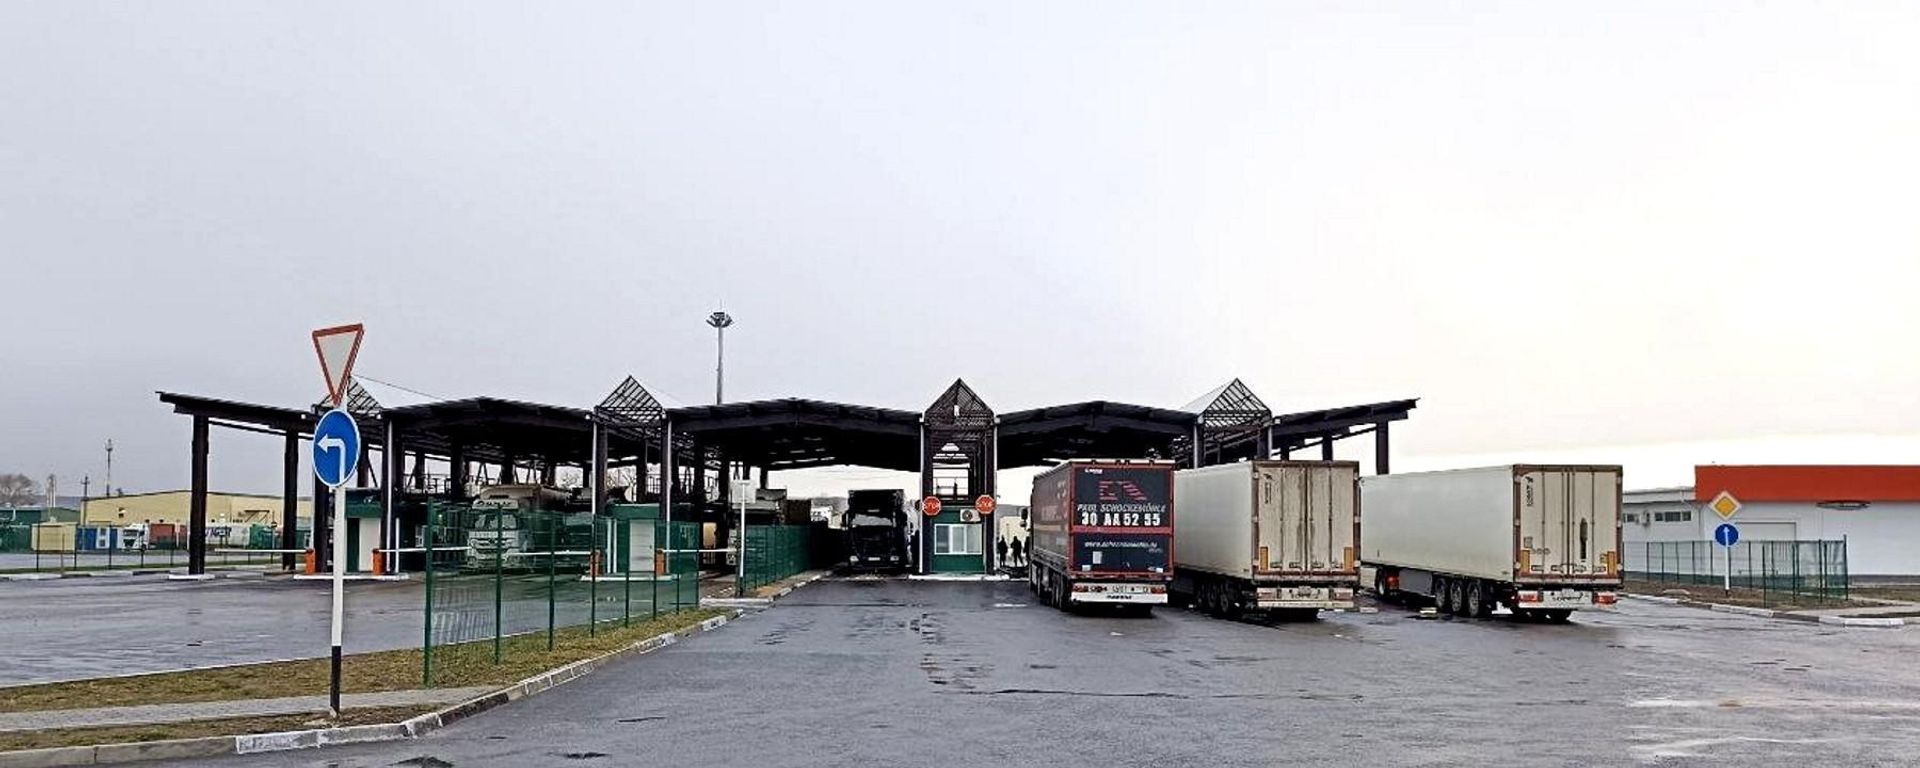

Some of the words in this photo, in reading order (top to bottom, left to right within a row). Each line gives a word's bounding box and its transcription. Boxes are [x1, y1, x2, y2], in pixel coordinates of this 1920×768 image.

[1077, 503, 1097, 512] PAUL
[1082, 512, 1097, 526] 30
[1104, 513, 1120, 526] AA
[1123, 513, 1139, 526] 52
[1144, 513, 1160, 526] 55
